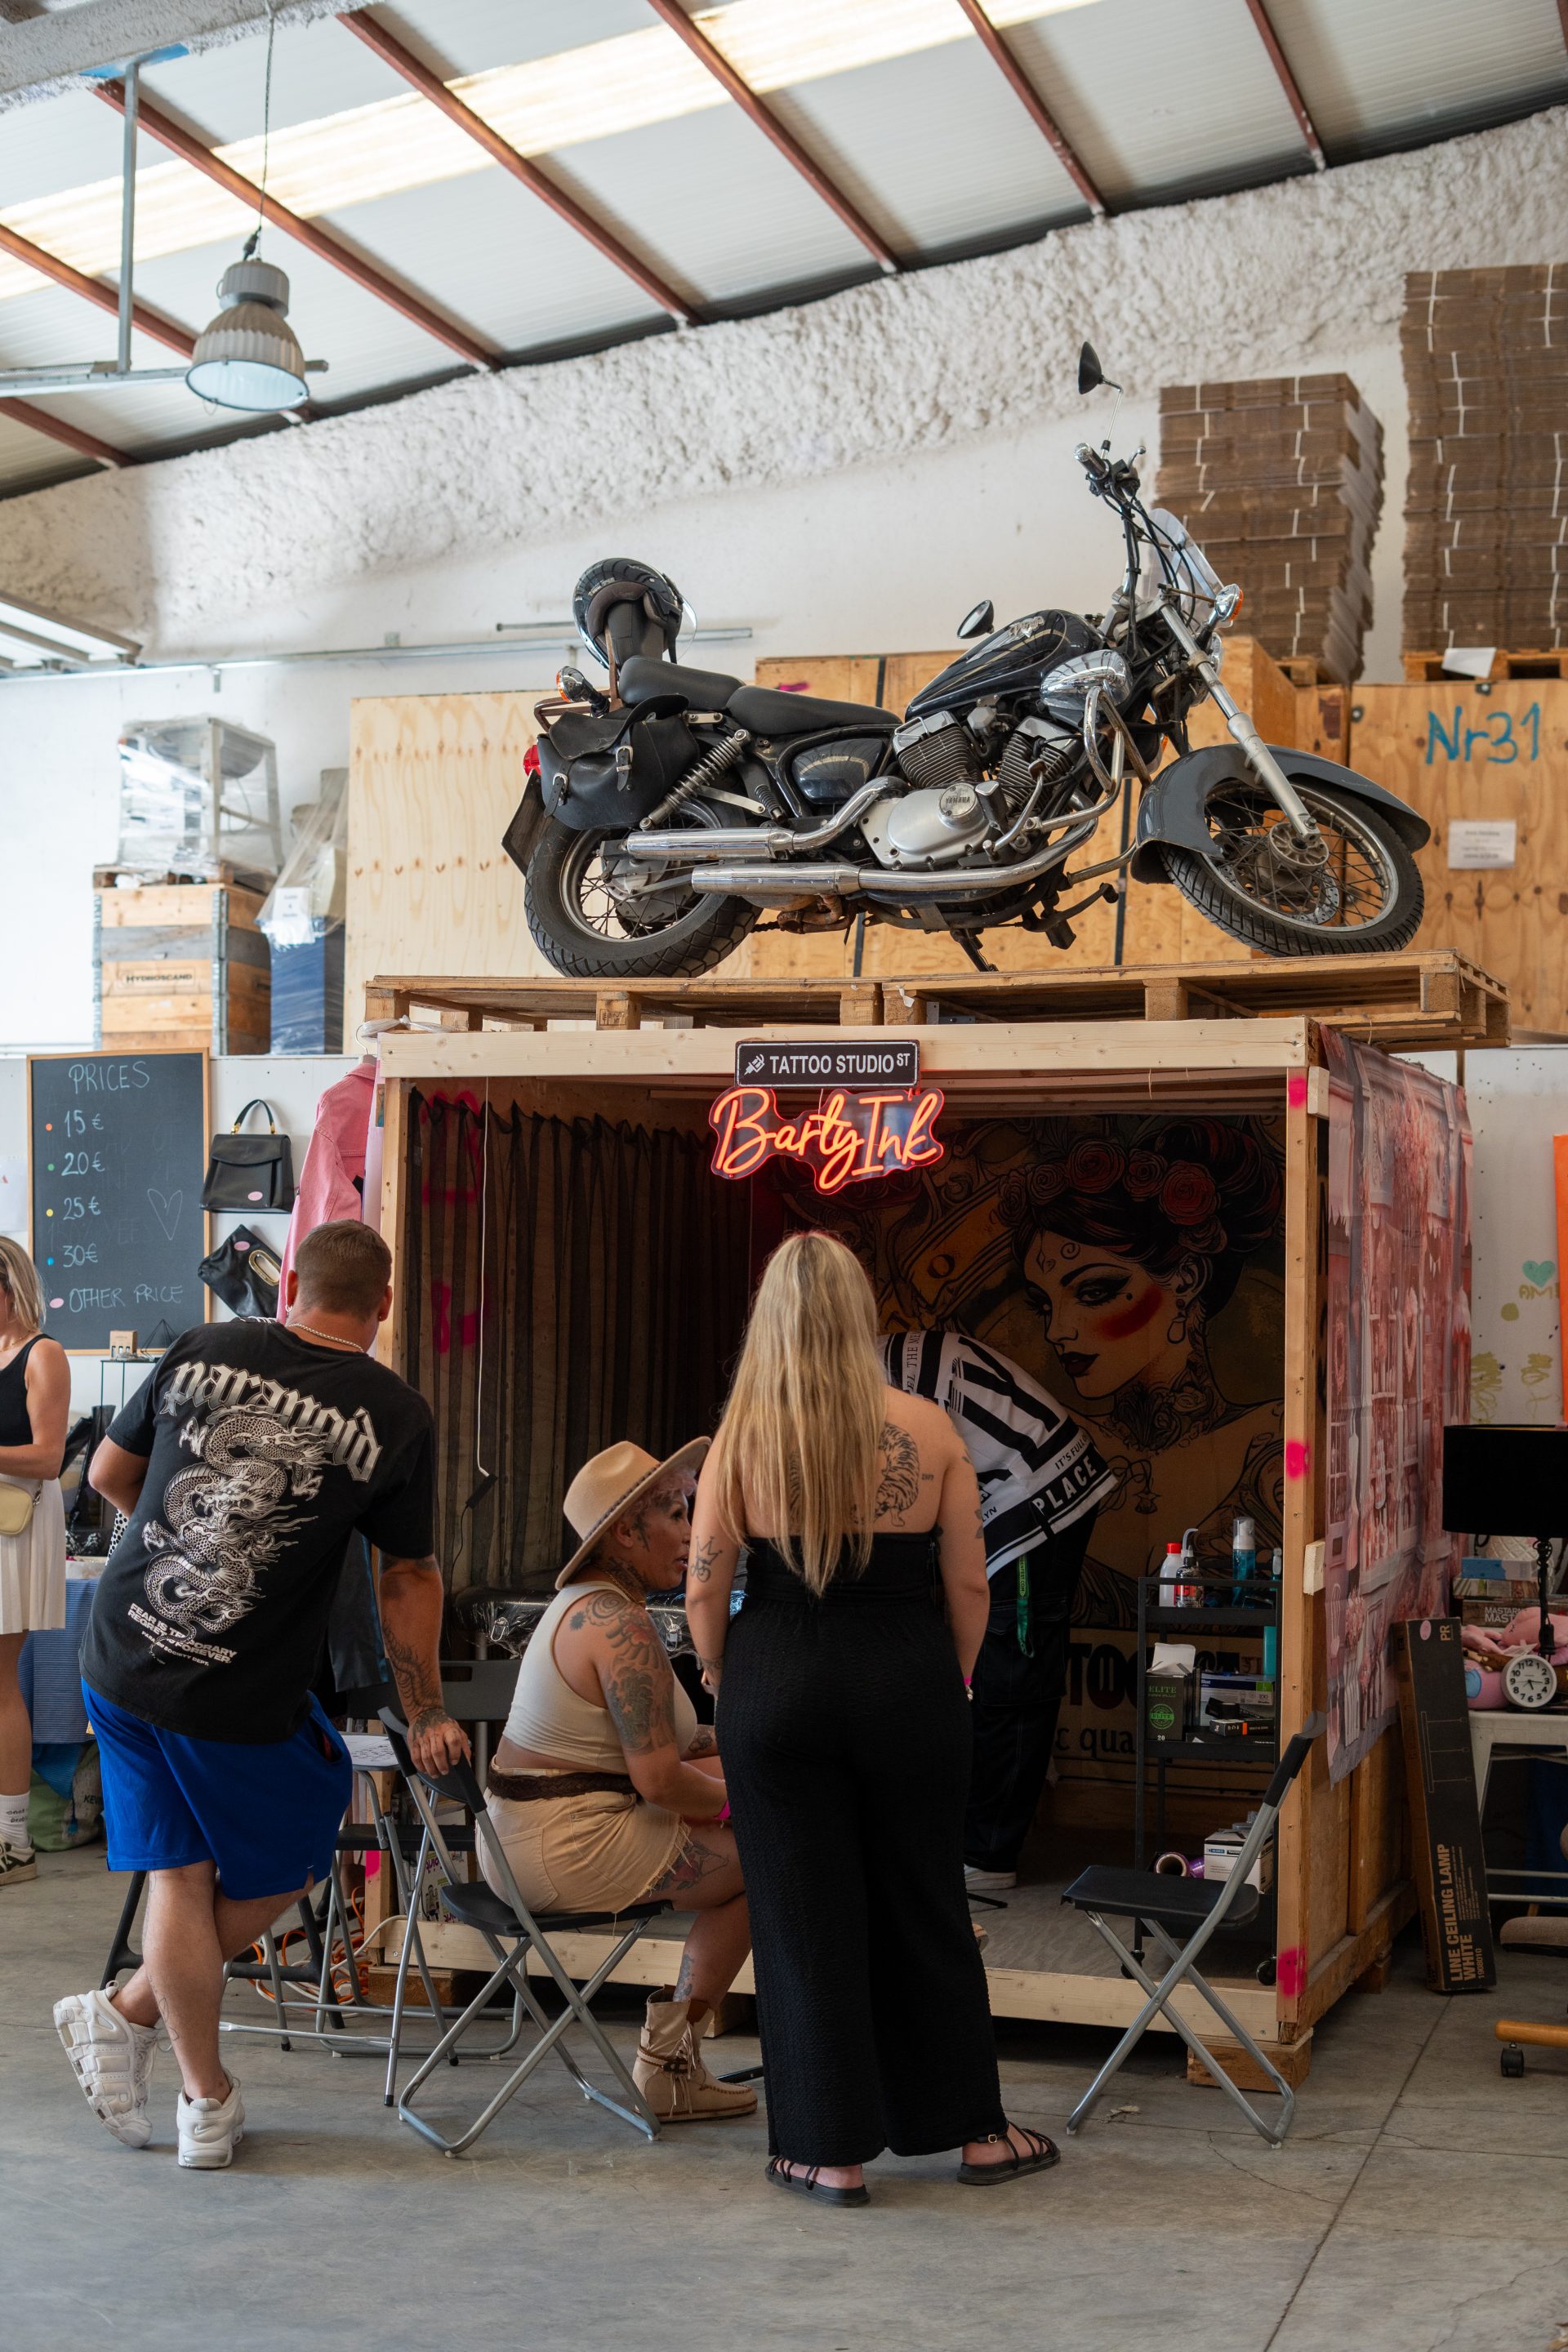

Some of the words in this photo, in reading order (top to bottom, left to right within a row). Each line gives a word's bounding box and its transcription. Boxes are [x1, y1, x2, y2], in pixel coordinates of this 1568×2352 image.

[69, 1061, 150, 1094] PRICES
[769, 1055, 831, 1074] TATTOO
[835, 1054, 895, 1074] STUDIO
[897, 1053, 911, 1067] ST
[69, 1288, 125, 1313] OTHER
[134, 1284, 184, 1304] PRICE
[906, 1347, 918, 1367] THE
[1071, 1441, 1085, 1456] FULL
[1032, 1455, 1098, 1516] PLACE
[127, 1609, 167, 1637] REGRET
[130, 1602, 157, 1625] FEAR
[157, 1619, 168, 1631] IS
[1439, 1625, 1450, 1642] PR
[163, 1645, 192, 1659] SOCIETY
[191, 1656, 210, 1666] DEPT.
[1148, 1685, 1177, 1694] ELITE
[1437, 1843, 1452, 1885] LAMP
[1441, 1888, 1459, 1945] CEILING
[1448, 1949, 1463, 1982] LINE
[1459, 1934, 1477, 1981] WHITE
